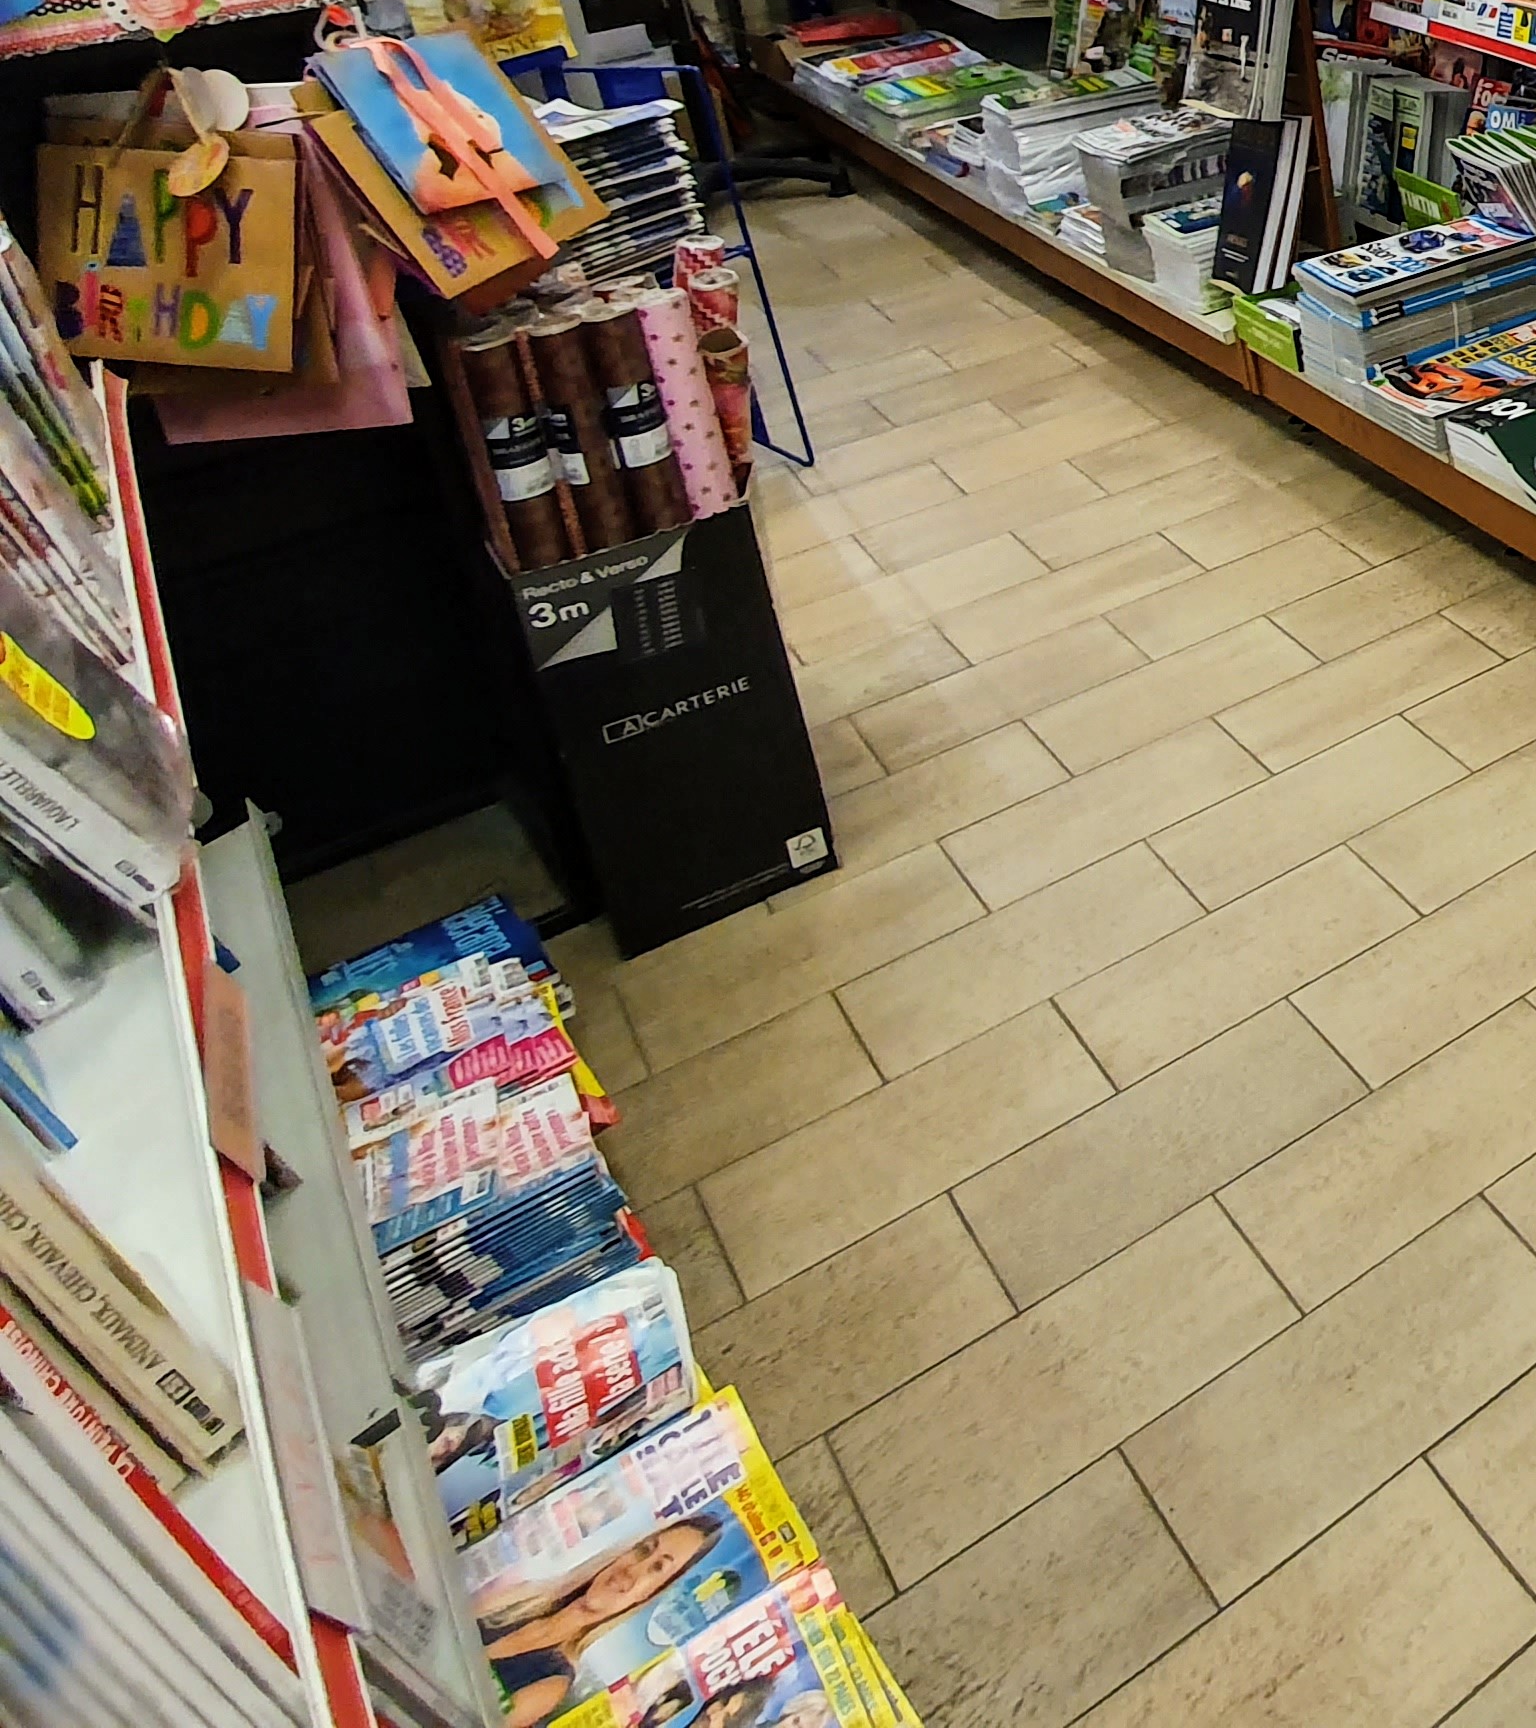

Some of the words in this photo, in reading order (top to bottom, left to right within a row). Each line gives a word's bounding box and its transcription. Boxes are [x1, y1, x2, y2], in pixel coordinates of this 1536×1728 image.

[71, 162, 255, 277] HAPPY
[54, 270, 278, 352] BIRTHDAY
[522, 577, 579, 600] Recto
[580, 571, 594, 584] &
[594, 555, 648, 579] Verso
